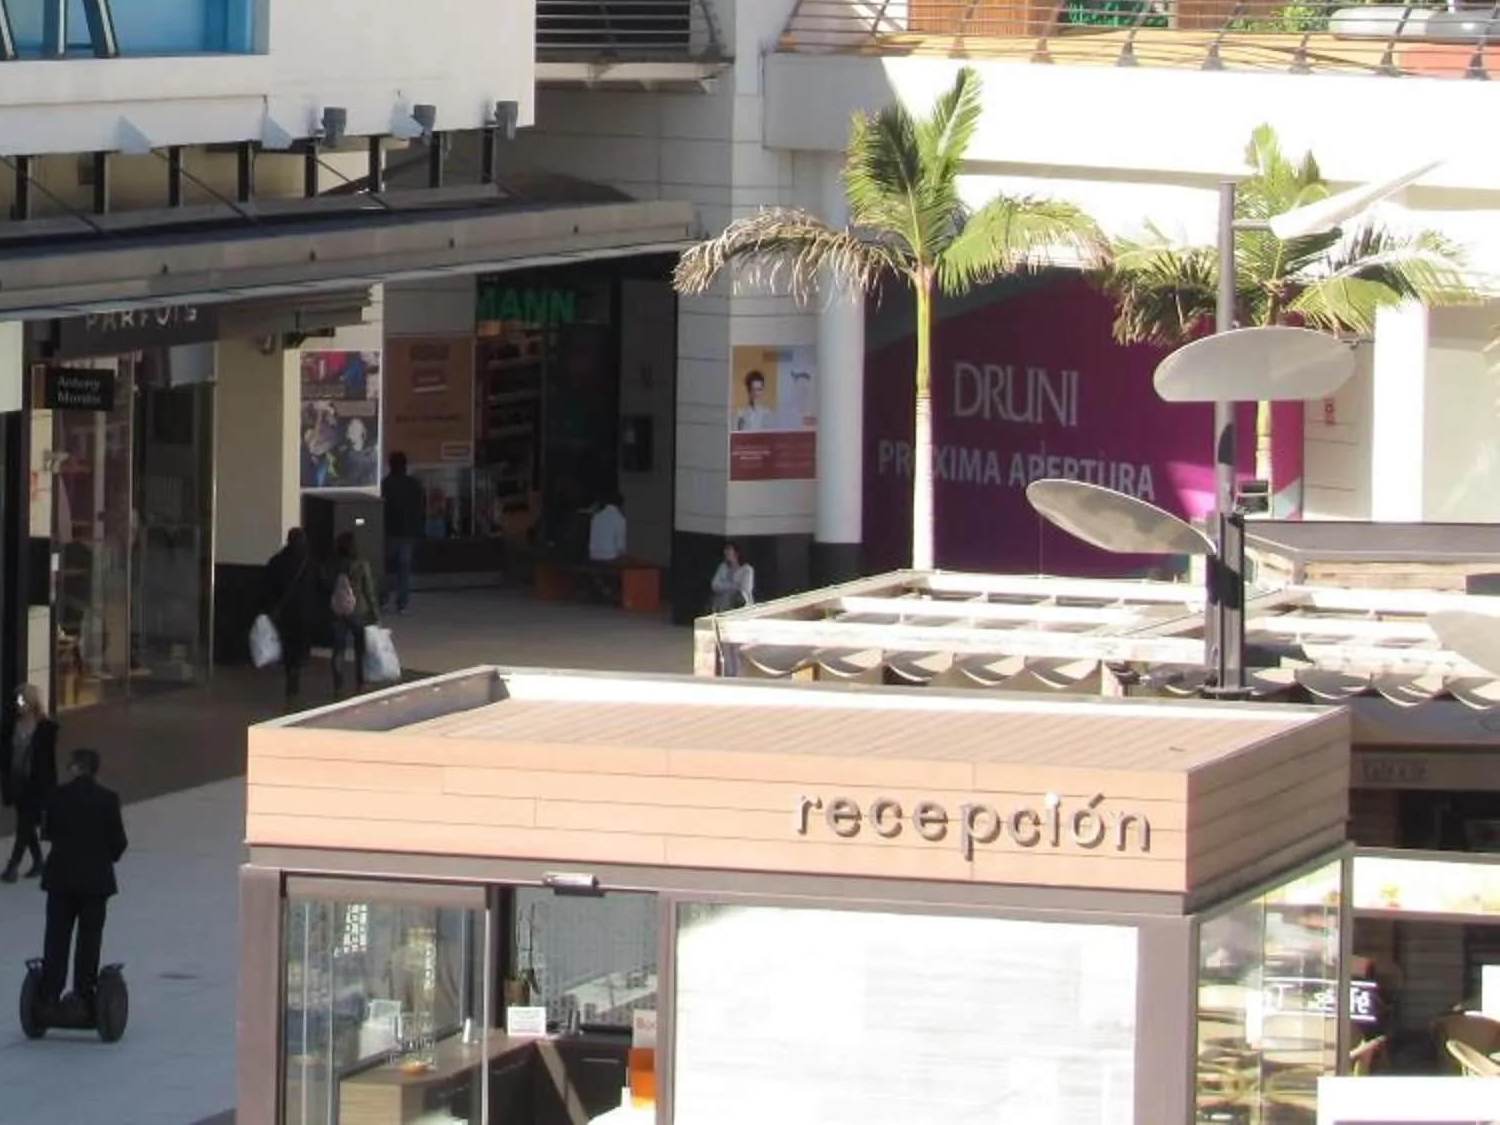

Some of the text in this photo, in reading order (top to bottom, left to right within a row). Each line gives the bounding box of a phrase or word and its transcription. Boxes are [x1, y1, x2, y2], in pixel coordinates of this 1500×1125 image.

[954, 362, 1080, 426] DRUNI
[878, 439, 1156, 500] PRXIMA APERTURA
[793, 792, 1152, 862] recepción
